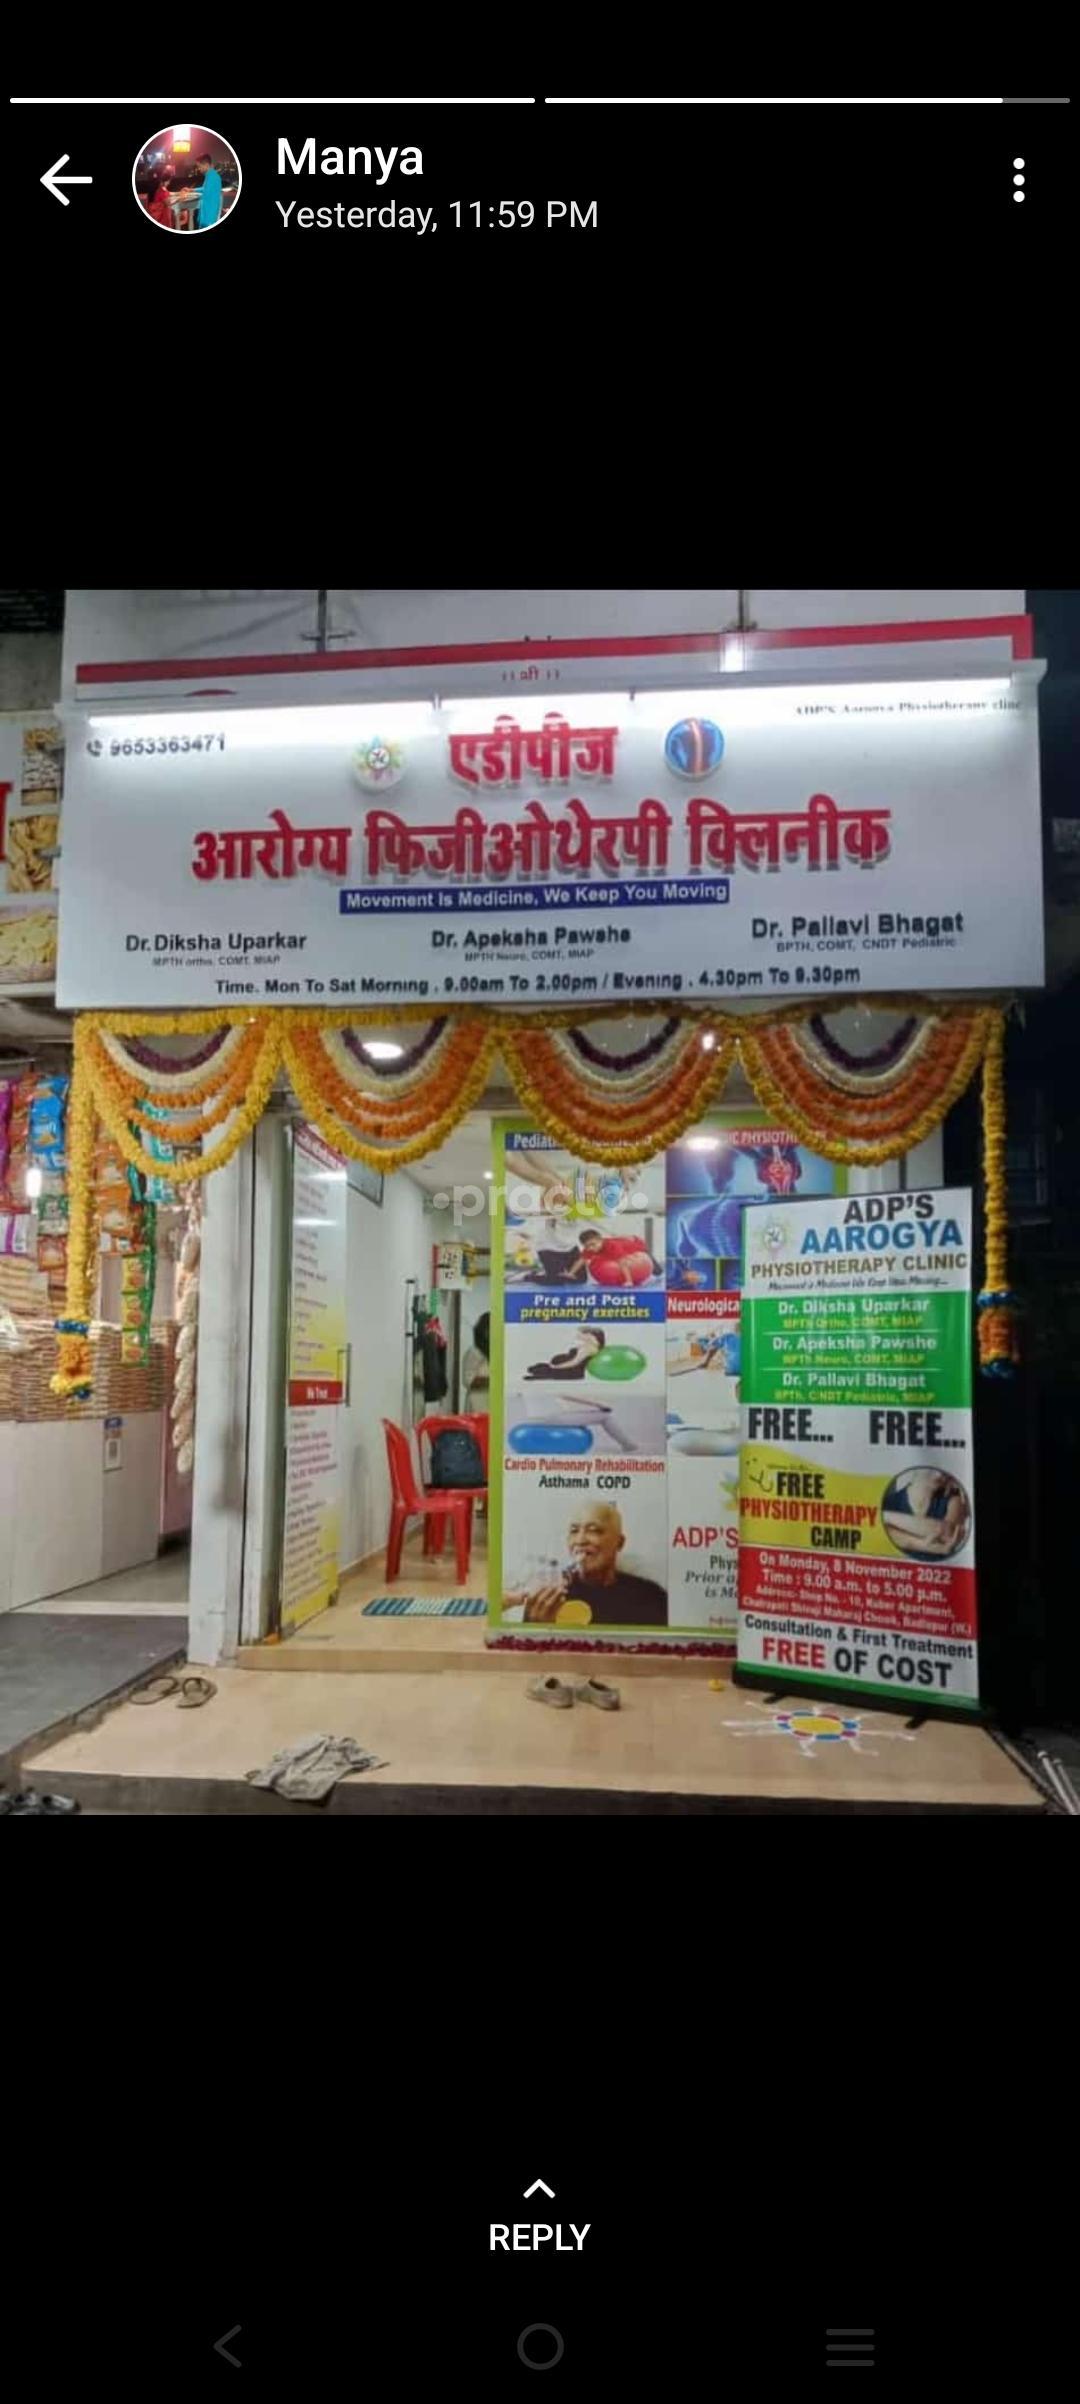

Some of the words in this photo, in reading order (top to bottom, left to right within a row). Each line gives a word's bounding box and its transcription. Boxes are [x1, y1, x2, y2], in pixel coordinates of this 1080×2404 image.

[110, 732, 226, 757] 9653363471
[448, 712, 619, 784] एडीपीज
[192, 809, 351, 882] आरोग्य
[365, 797, 673, 878] फिजीओथेरपी
[686, 794, 892, 868] क्लिनीक
[346, 892, 434, 908] Movement
[458, 889, 539, 906] Medicine,
[544, 888, 570, 902] We
[575, 886, 619, 904] Keep
[624, 885, 657, 899] You
[663, 883, 727, 901] Moving
[752, 918, 783, 938] Dr.
[792, 914, 870, 937] Pallavi
[878, 911, 964, 937] Bhagat
[125, 934, 151, 952] Dr.
[154, 933, 222, 951] Diksha
[228, 931, 307, 954] Uparkar
[432, 930, 458, 948] Dr.
[463, 929, 548, 950] Apeksha
[555, 925, 631, 946] Pawshe
[265, 979, 300, 993] Mon
[305, 978, 325, 993] To
[329, 978, 356, 992] Sat
[361, 977, 429, 995] Morning
[444, 976, 504, 992] 9.00am
[510, 975, 529, 990] To
[536, 973, 597, 993] 2.00pm
[613, 971, 682, 990] Evening
[699, 970, 763, 989] 4.30pm
[769, 967, 790, 983] To
[514, 1133, 557, 1148] Pediat
[843, 1194, 934, 1224] ADP'S
[800, 1220, 963, 1254] AAROGYA
[751, 1256, 896, 1278] PHYSIOTHERAPY
[903, 1253, 968, 1270] CLINIC
[534, 1294, 562, 1306] Pre
[566, 1294, 597, 1306] and
[602, 1294, 636, 1306] Post
[667, 1296, 740, 1317] Neurologica
[779, 1301, 798, 1315] Dr.
[803, 1299, 855, 1314] Diksha
[862, 1297, 930, 1314] Uparkar
[520, 1307, 588, 1321] pregnancy
[593, 1306, 650, 1319] exercises
[773, 1337, 792, 1351] Dr.
[797, 1336, 865, 1352] Apeksha
[871, 1335, 937, 1350] Pawshe
[783, 1373, 800, 1386] Dr.
[808, 1372, 860, 1387] Pallavi
[865, 1373, 926, 1390] Bhagat
[748, 1407, 834, 1442] FREE...
[870, 1410, 966, 1448] FREE...
[505, 1458, 537, 1471] Cardio
[539, 1458, 594, 1475] Pulmonary
[595, 1458, 665, 1473] Rehabilitation
[538, 1475, 590, 1488] Asthama
[596, 1475, 631, 1489] COPD
[776, 1471, 825, 1499] FREE
[740, 1497, 878, 1527] PHYSIOTHERAPY
[672, 1526, 739, 1549] ADP'S
[810, 1525, 863, 1550] CAMP
[759, 1552, 776, 1567] On
[778, 1554, 831, 1574] Monday,
[833, 1560, 841, 1572] 8
[845, 1561, 912, 1580] November
[917, 1567, 952, 1584] 2022
[762, 1569, 794, 1584] Time
[804, 1573, 831, 1589] 9.00
[834, 1581, 862, 1593] a.m.
[866, 1581, 880, 1594] to
[884, 1581, 913, 1597] 5.00
[917, 1590, 948, 1605] p.m.
[745, 1615, 832, 1640] Consultation
[837, 1627, 848, 1642] &
[853, 1629, 887, 1648] First
[891, 1634, 974, 1660] Treatment
[762, 1637, 826, 1669] FREE
[834, 1648, 867, 1674] OF
[877, 1653, 952, 1688] COST
